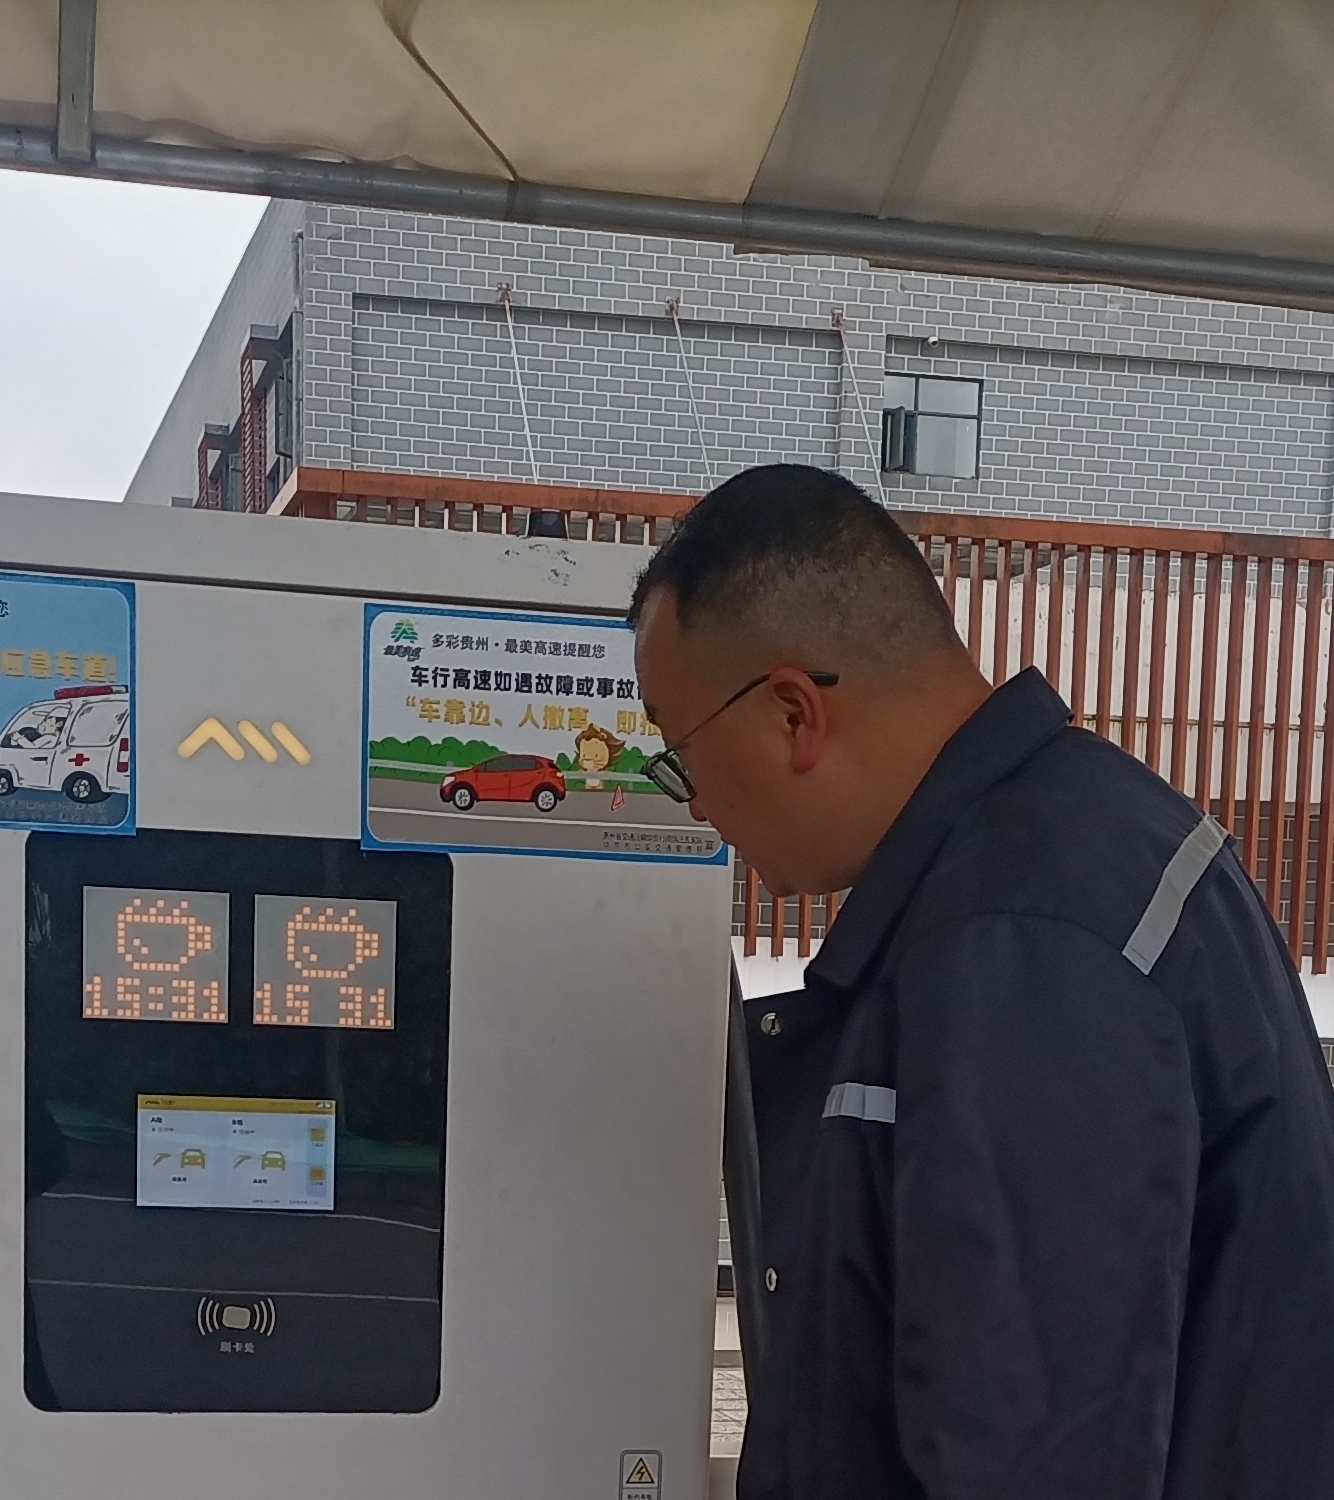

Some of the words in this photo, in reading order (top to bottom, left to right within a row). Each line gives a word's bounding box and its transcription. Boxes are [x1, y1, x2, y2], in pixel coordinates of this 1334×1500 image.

[410, 665, 642, 701] 车行高速如遇故障或事故
[85, 976, 226, 1020] 15:31
